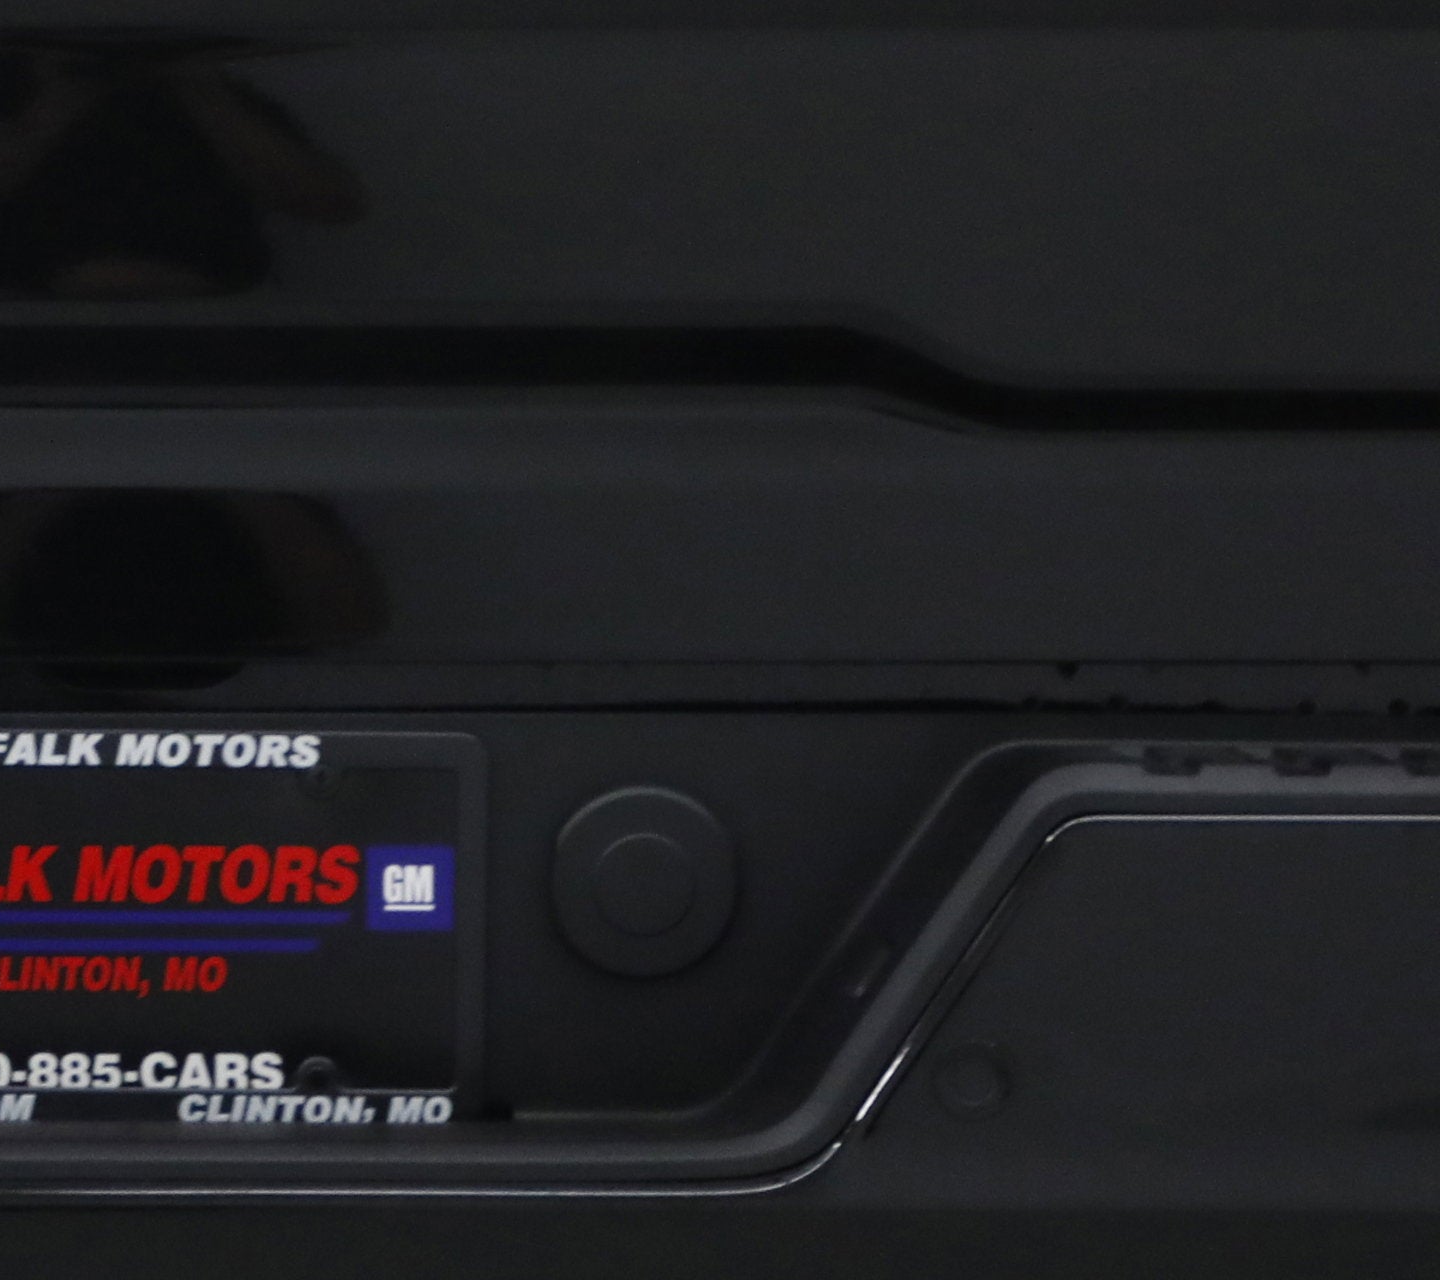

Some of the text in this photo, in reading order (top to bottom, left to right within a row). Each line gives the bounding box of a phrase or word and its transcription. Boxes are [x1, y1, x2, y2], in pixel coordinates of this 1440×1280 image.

[115, 733, 322, 770] MOTORS
[73, 844, 362, 906] MOTORS
[383, 864, 437, 904] GM
[163, 956, 229, 993] MO
[178, 1095, 453, 1126] CLINTON, MO
